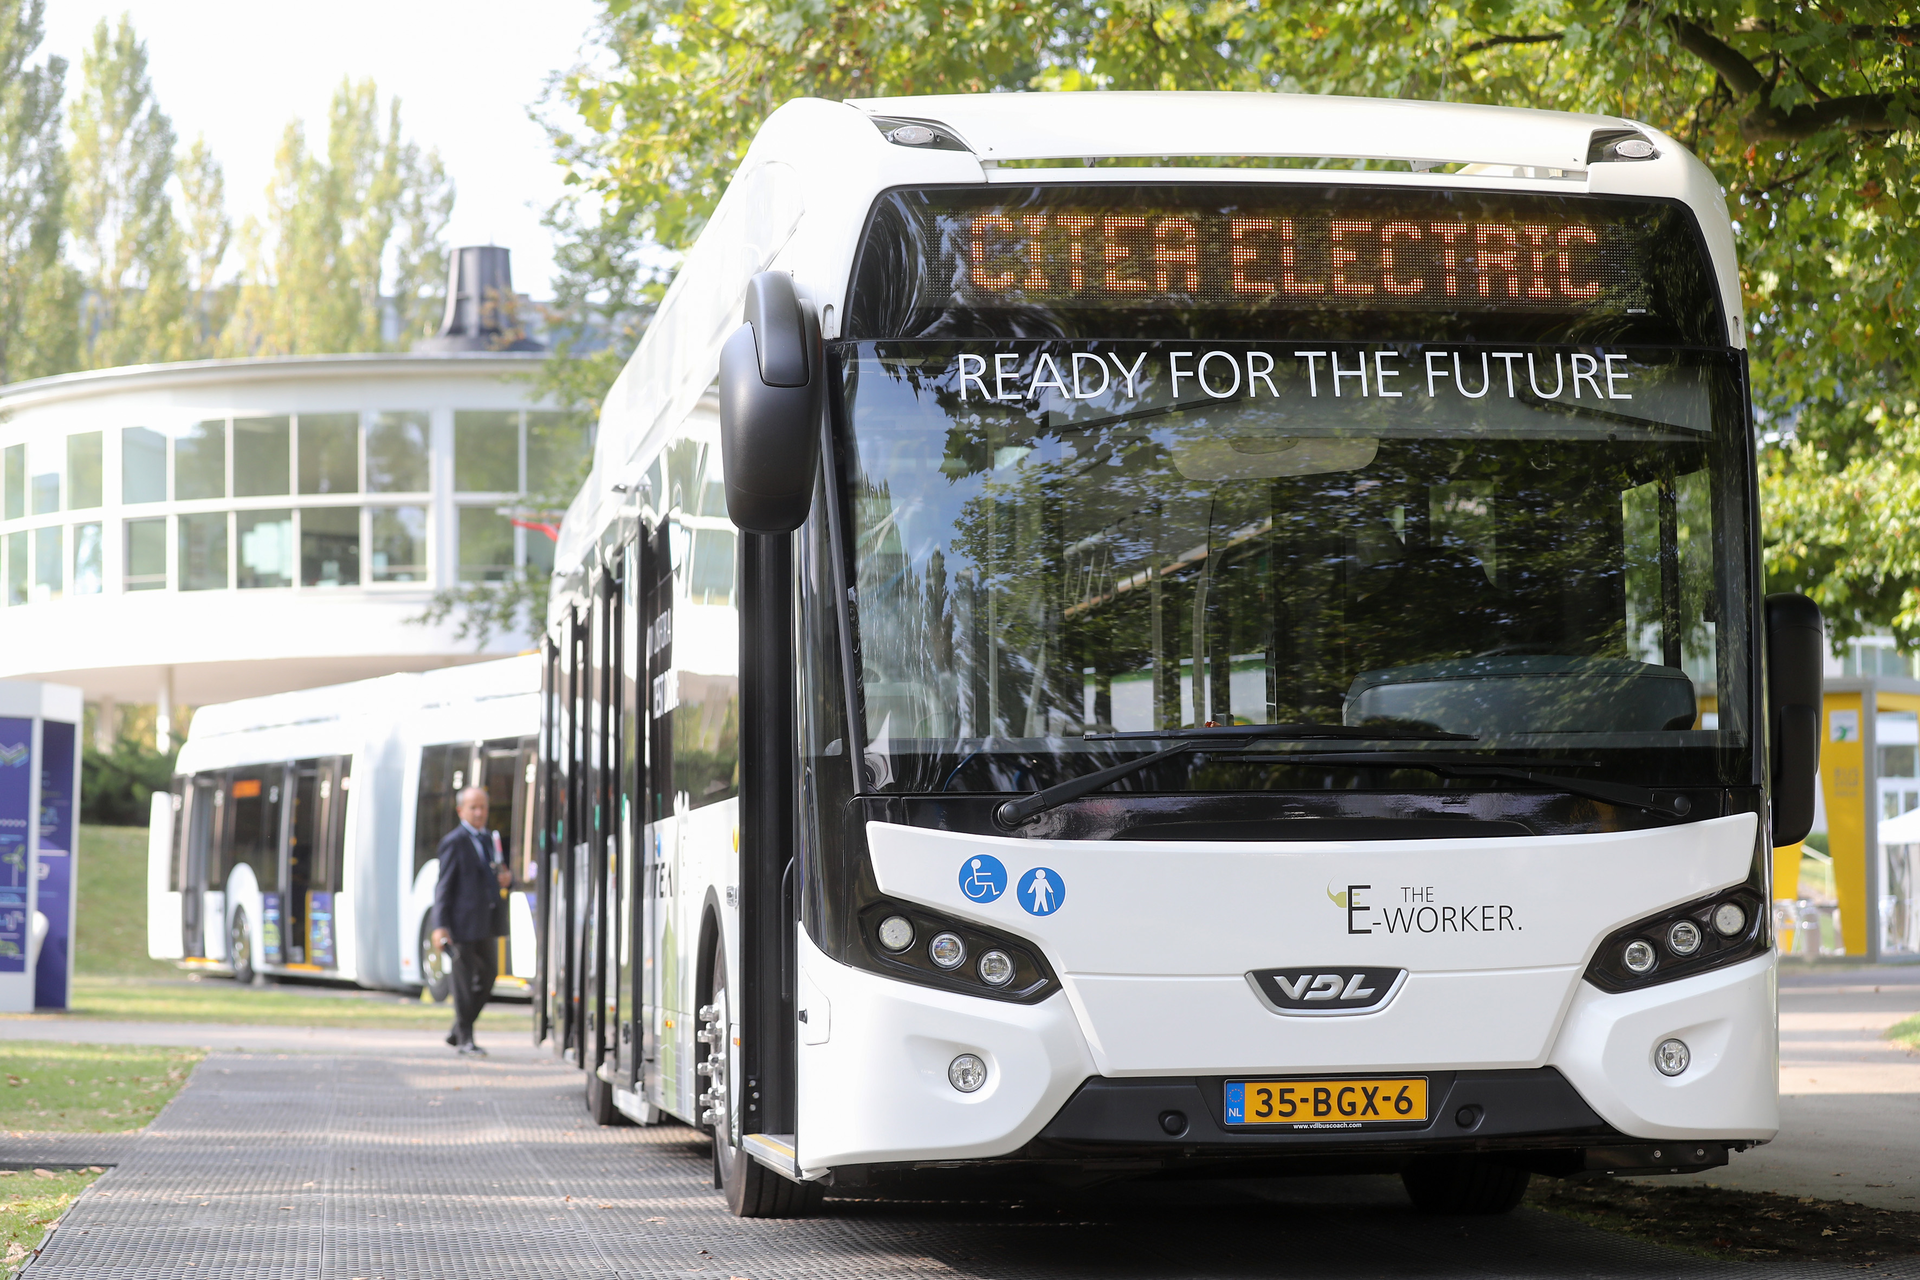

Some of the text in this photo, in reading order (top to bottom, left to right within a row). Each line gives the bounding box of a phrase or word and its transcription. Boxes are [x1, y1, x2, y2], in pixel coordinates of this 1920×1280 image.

[971, 214, 1600, 299] CITEA ELECTRIC
[958, 350, 1633, 401] READY FOR THE FUTURE
[1347, 884, 1523, 934] E-WORKER.
[1400, 886, 1435, 903] THE
[1272, 973, 1376, 1000] VDL
[1228, 1107, 1242, 1118] NL
[1255, 1085, 1413, 1118] 35-BGX-6
[1292, 1122, 1362, 1130] www.vdlbuscoach.com
